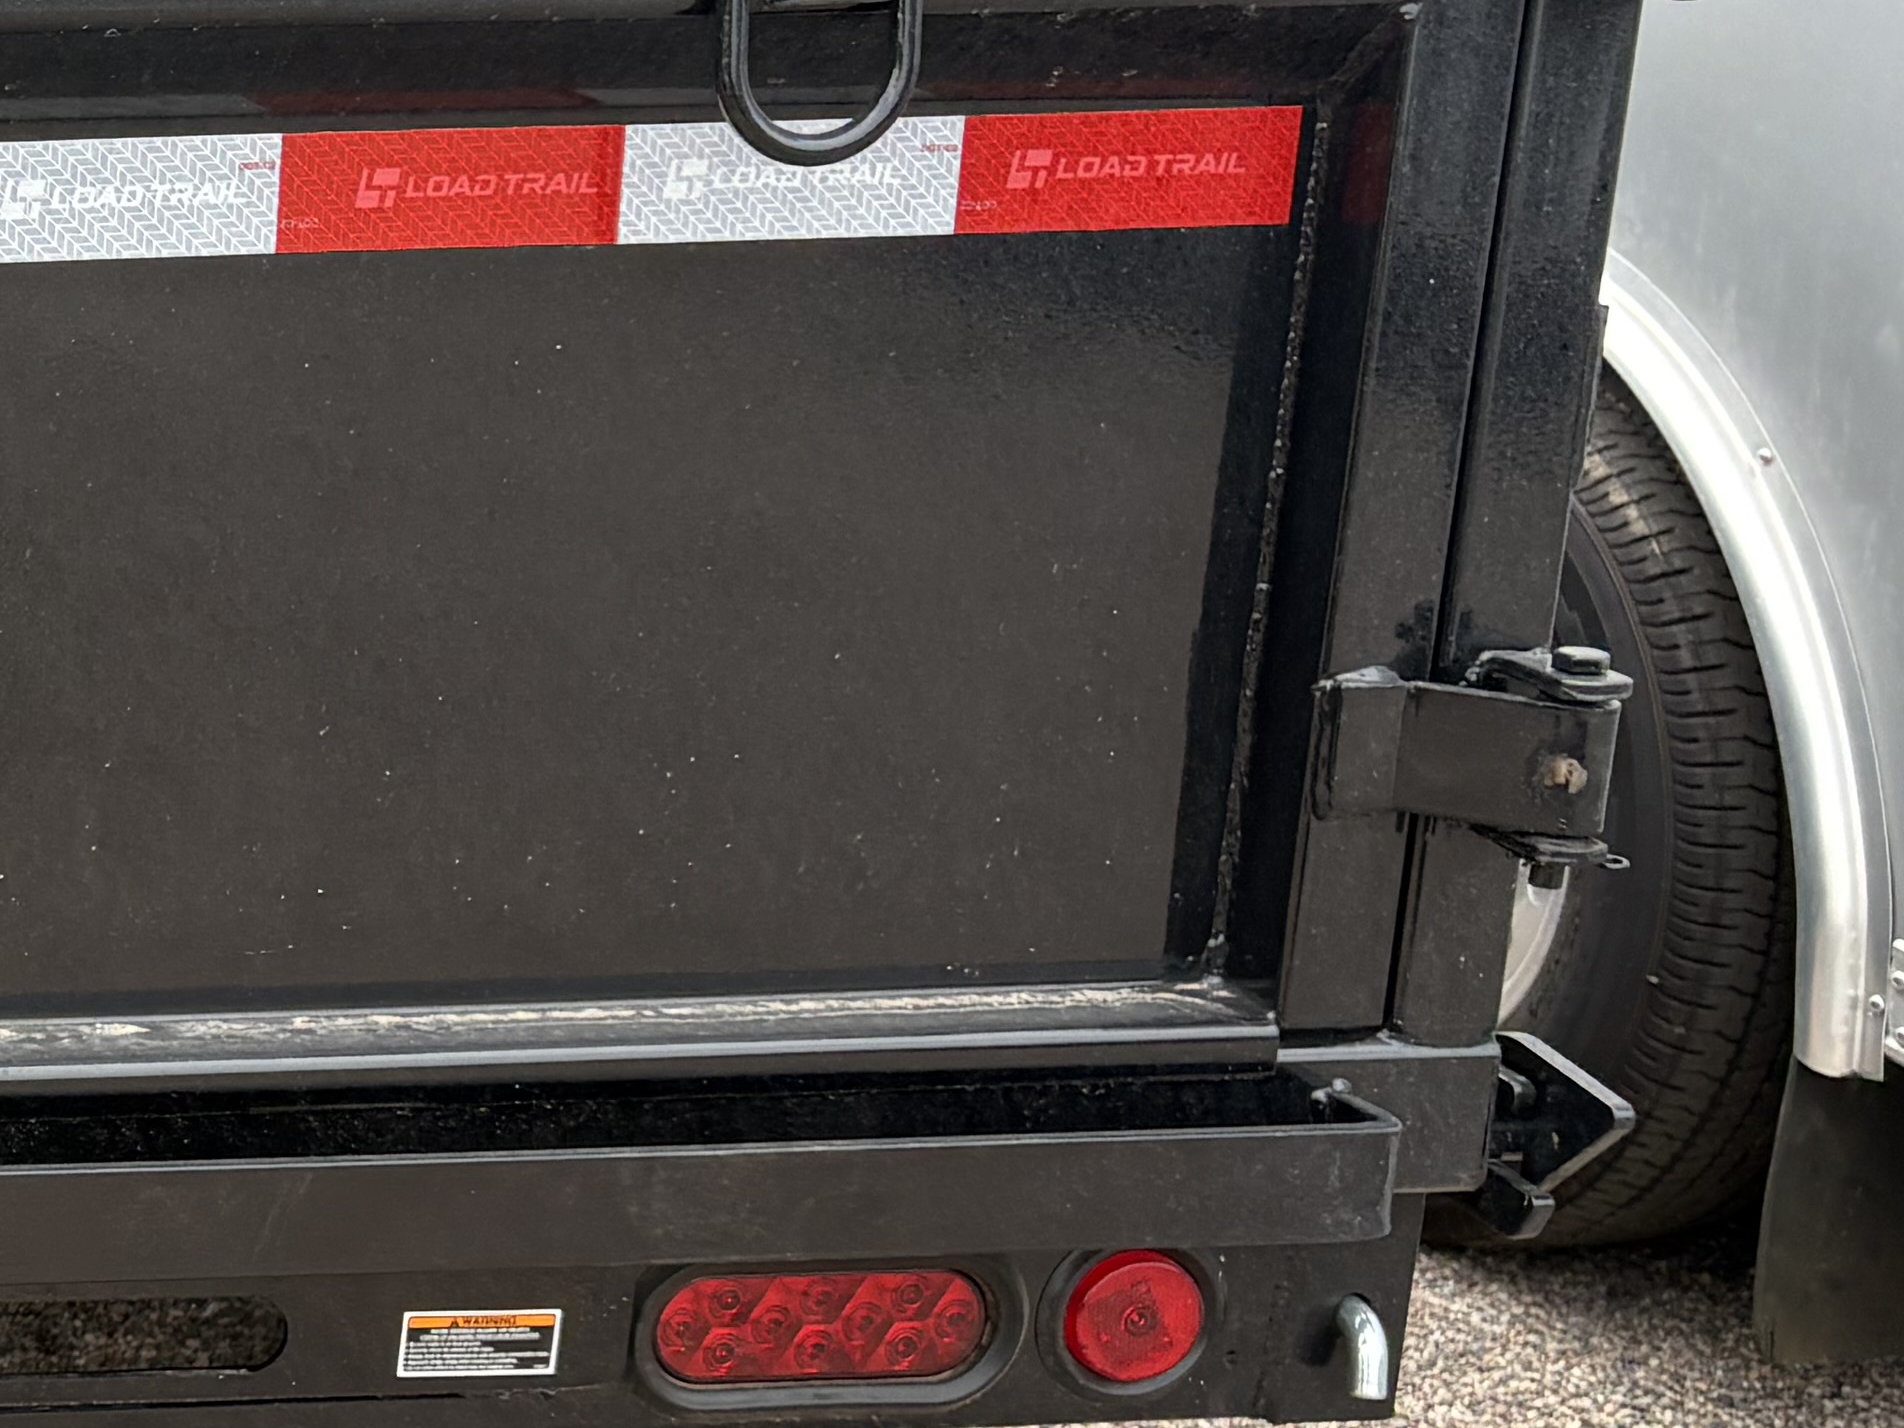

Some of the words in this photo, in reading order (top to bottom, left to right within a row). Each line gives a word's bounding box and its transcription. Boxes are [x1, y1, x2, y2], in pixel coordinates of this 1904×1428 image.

[1056, 155, 1146, 179] LOAD
[1148, 152, 1246, 174] TRAIL
[405, 176, 499, 198] LOAD
[504, 172, 598, 195] TRAIL
